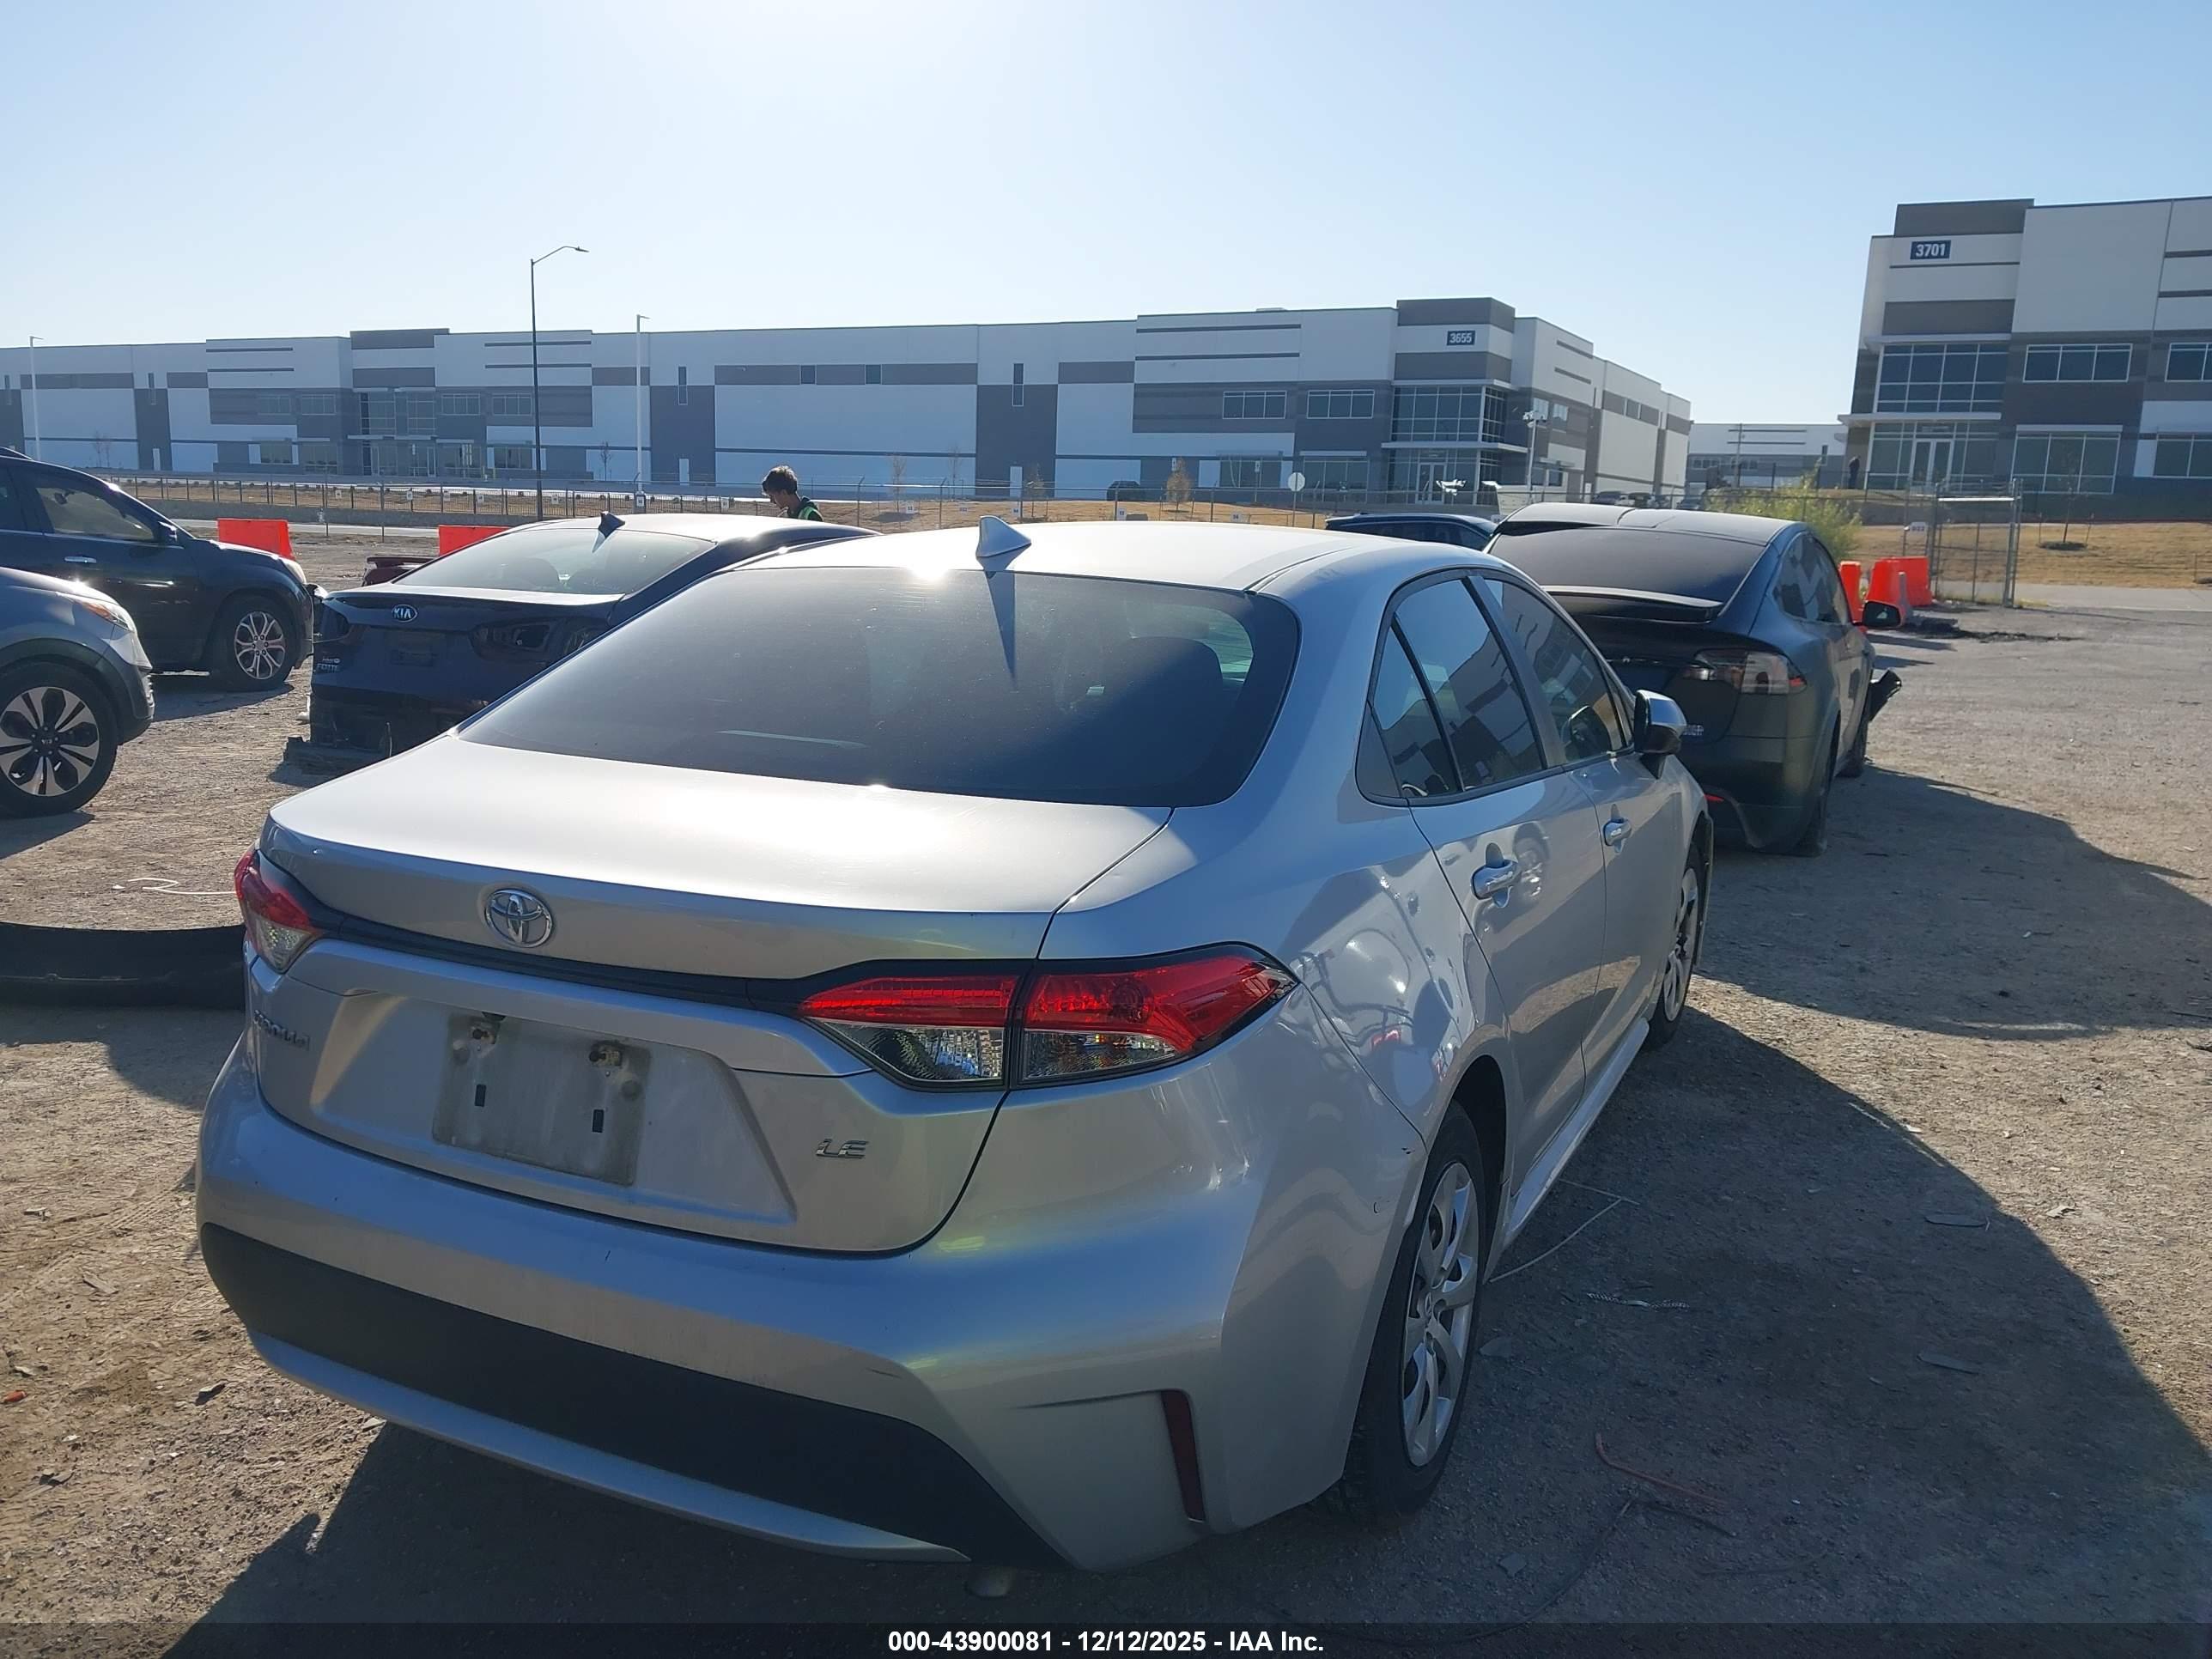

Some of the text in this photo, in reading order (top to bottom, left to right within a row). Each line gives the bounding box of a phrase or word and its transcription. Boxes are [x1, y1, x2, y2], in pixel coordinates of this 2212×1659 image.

[1915, 243, 1946, 257] 3701
[1449, 332, 1473, 343] 3655
[815, 1138, 870, 1159] LE
